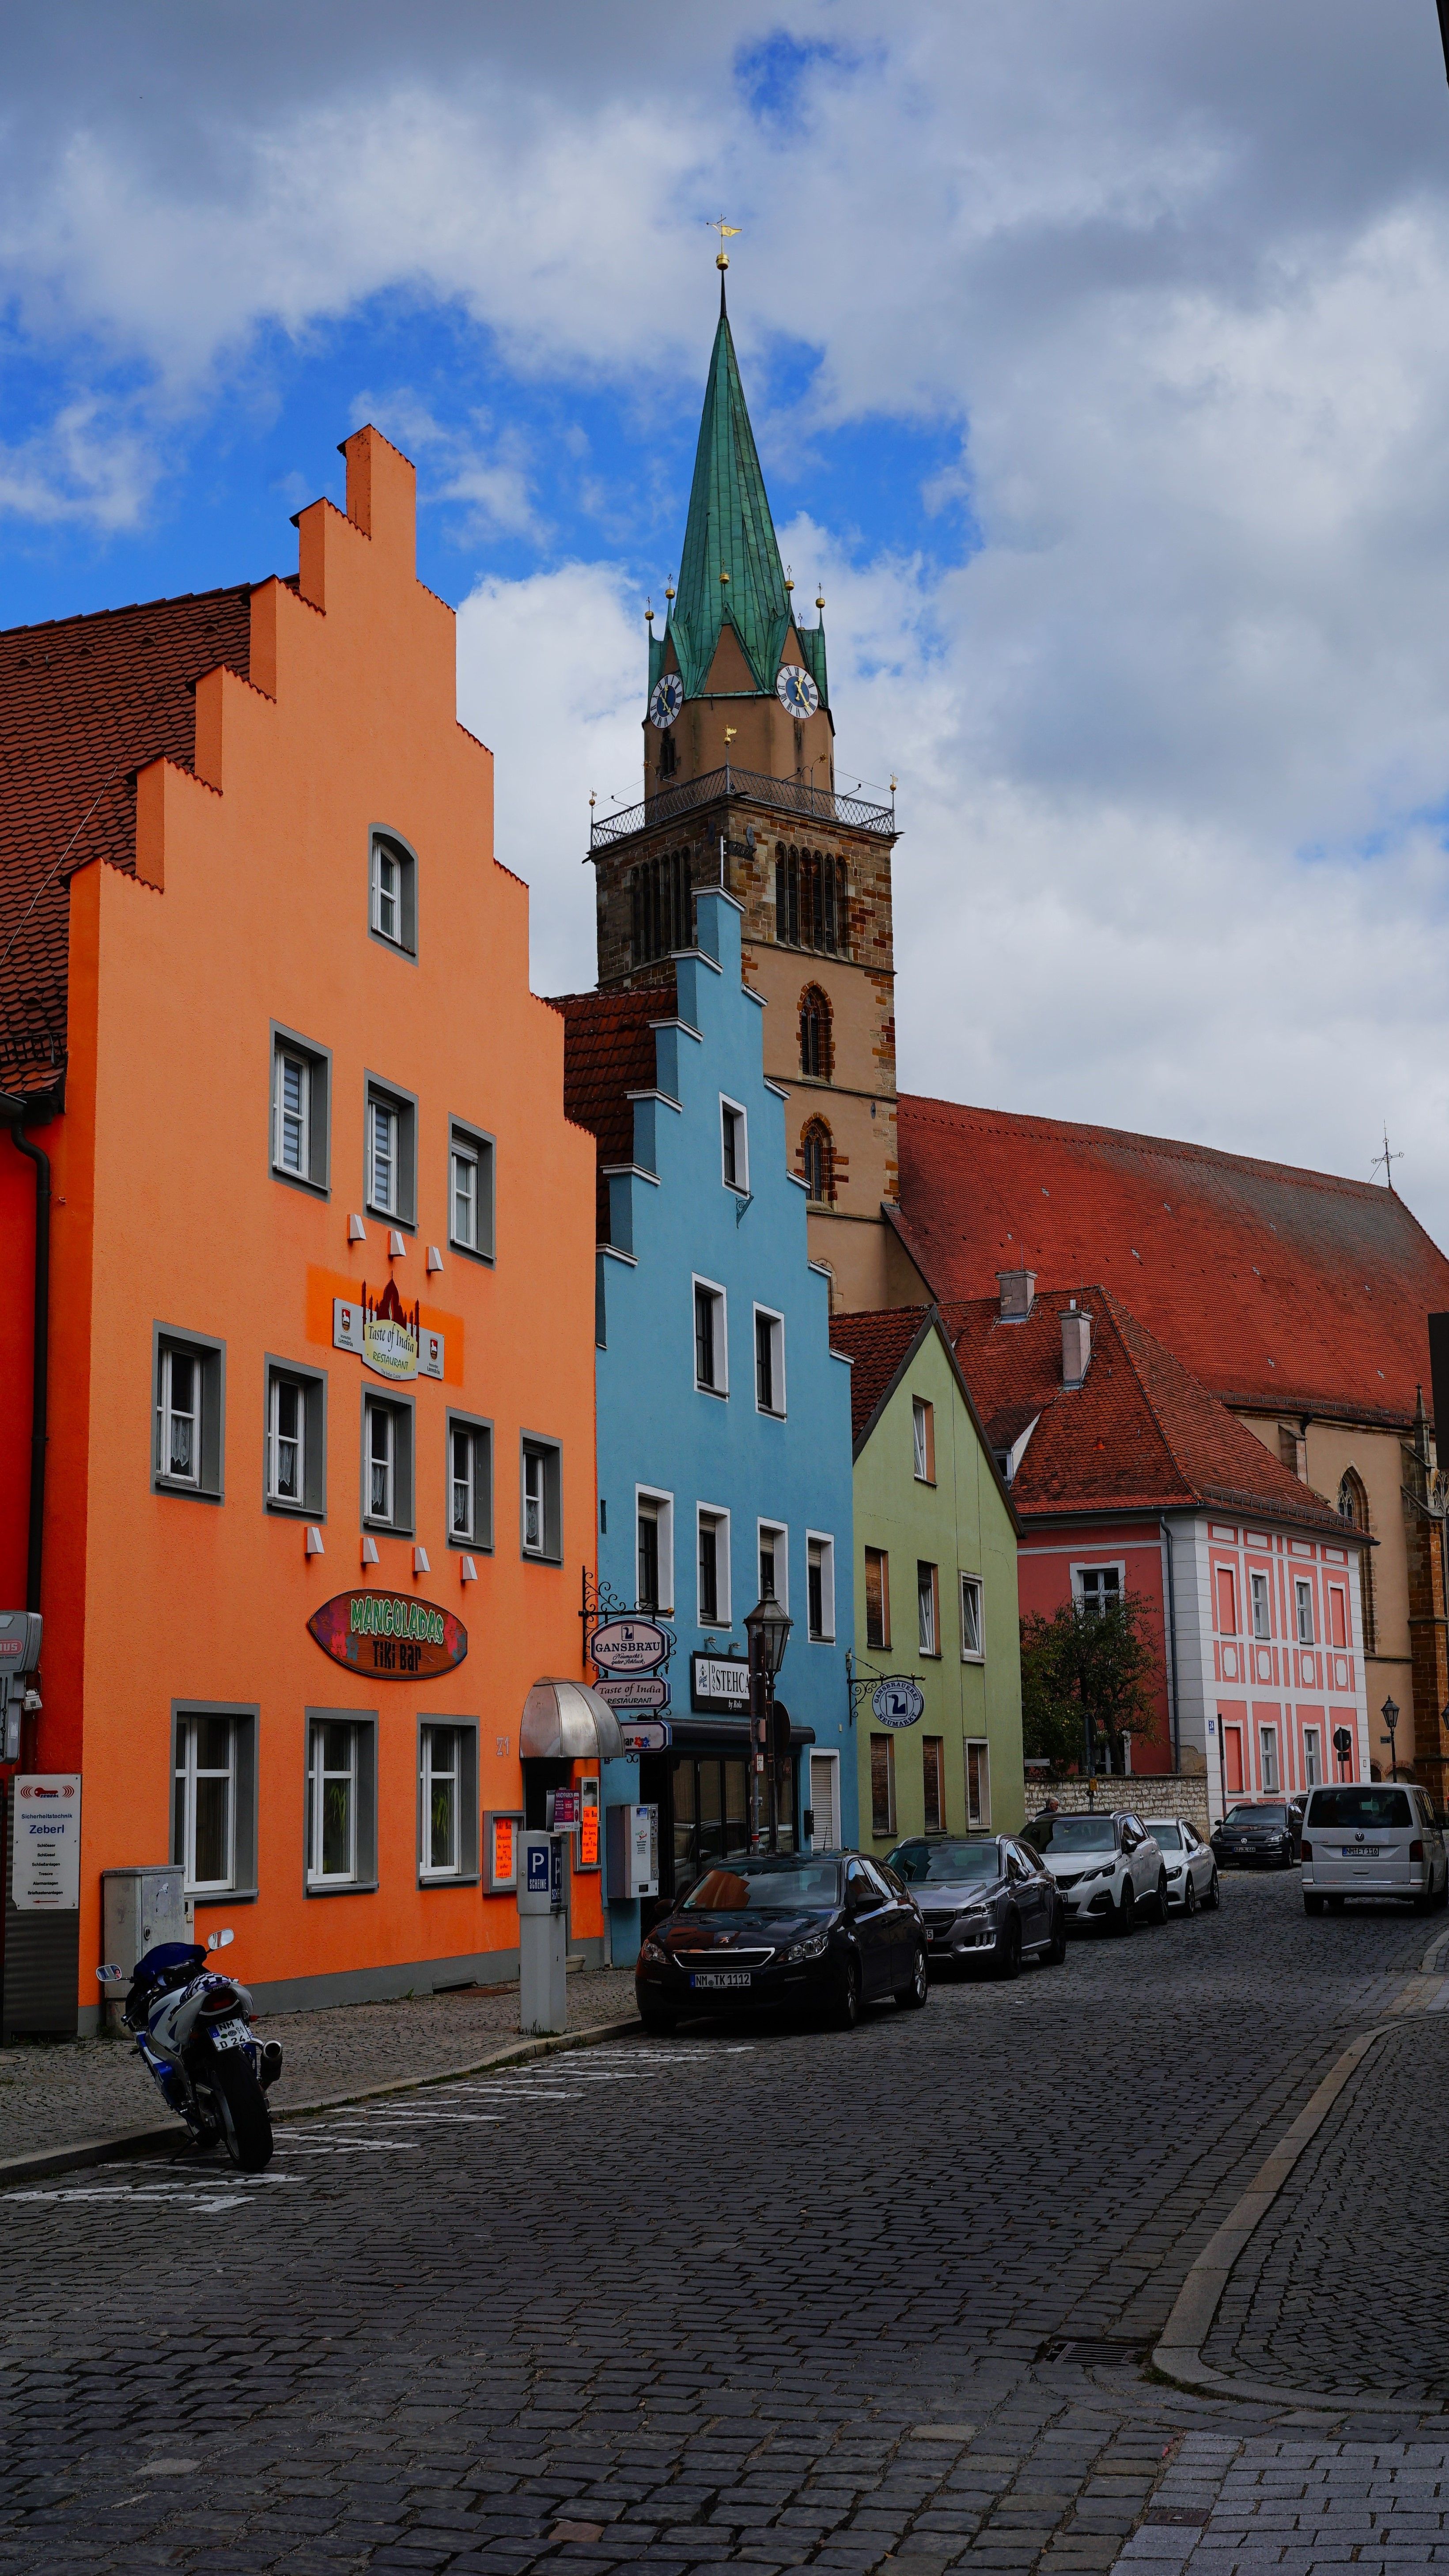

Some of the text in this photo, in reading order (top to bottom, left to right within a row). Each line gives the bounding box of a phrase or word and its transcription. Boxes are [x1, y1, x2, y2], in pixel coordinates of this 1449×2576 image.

[368, 1324, 414, 1353] Taste of India
[373, 1351, 409, 1371] RESTAURANT
[351, 1595, 443, 1645] MANGOLADAS
[595, 1642, 661, 1653] GANSBRÄU
[599, 1683, 661, 1697] Taste of India
[874, 1682, 919, 1703] GANSBRAUEREI
[729, 1699, 733, 1710] by
[878, 1712, 917, 1726] NEUMARKT
[624, 1738, 634, 1746] ar
[29, 1824, 64, 1834] Zeberl
[533, 1853, 545, 1872] P
[530, 1879, 547, 1889] SCHEINE
[696, 1975, 707, 1986] NM
[714, 1975, 726, 1986] TK
[727, 1974, 750, 1985] 1112
[218, 2021, 235, 2031] NM
[231, 2035, 246, 2046] 24
